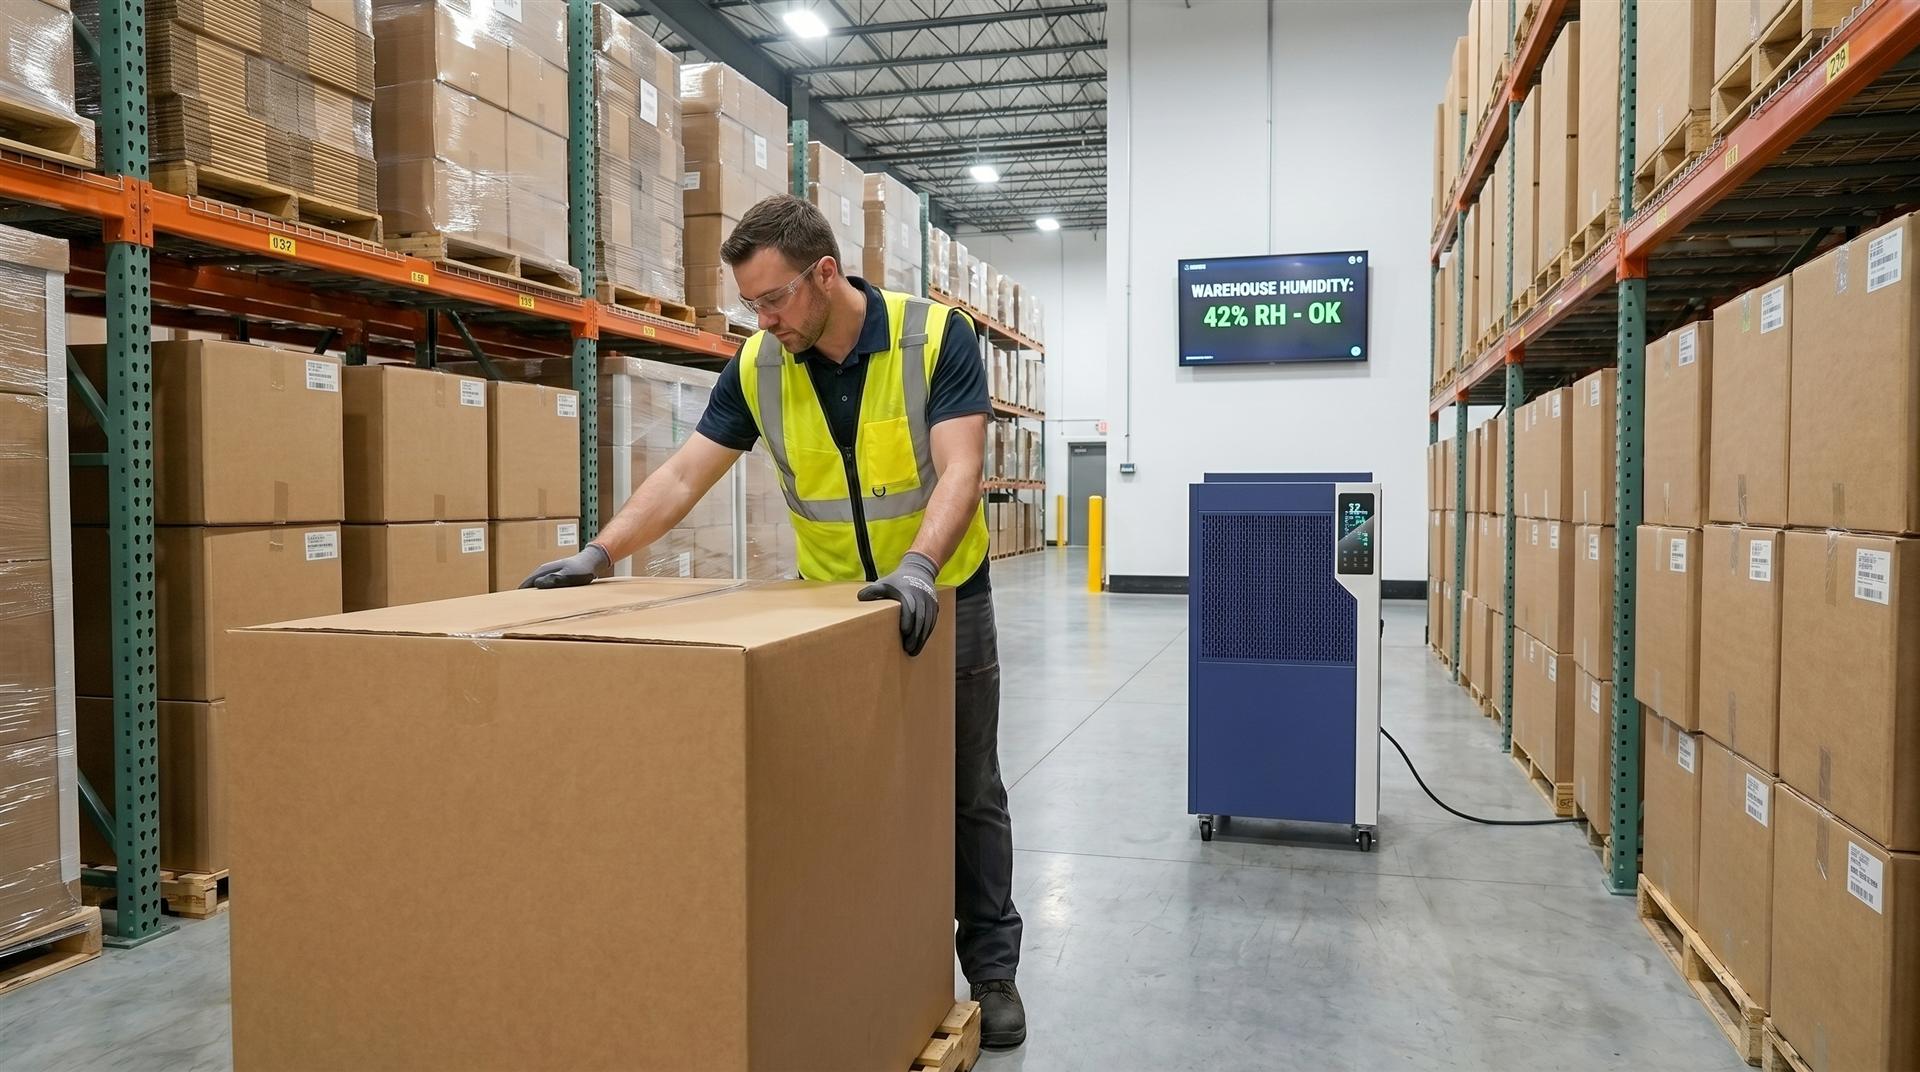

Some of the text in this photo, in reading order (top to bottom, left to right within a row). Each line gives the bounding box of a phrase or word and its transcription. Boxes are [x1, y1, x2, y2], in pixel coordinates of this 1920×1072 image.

[1191, 278, 1354, 298] WAREHOUSE HUMIDITY:
[1203, 305, 1248, 327] 42%
[1255, 303, 1286, 326] RH
[1308, 301, 1341, 324] OK
